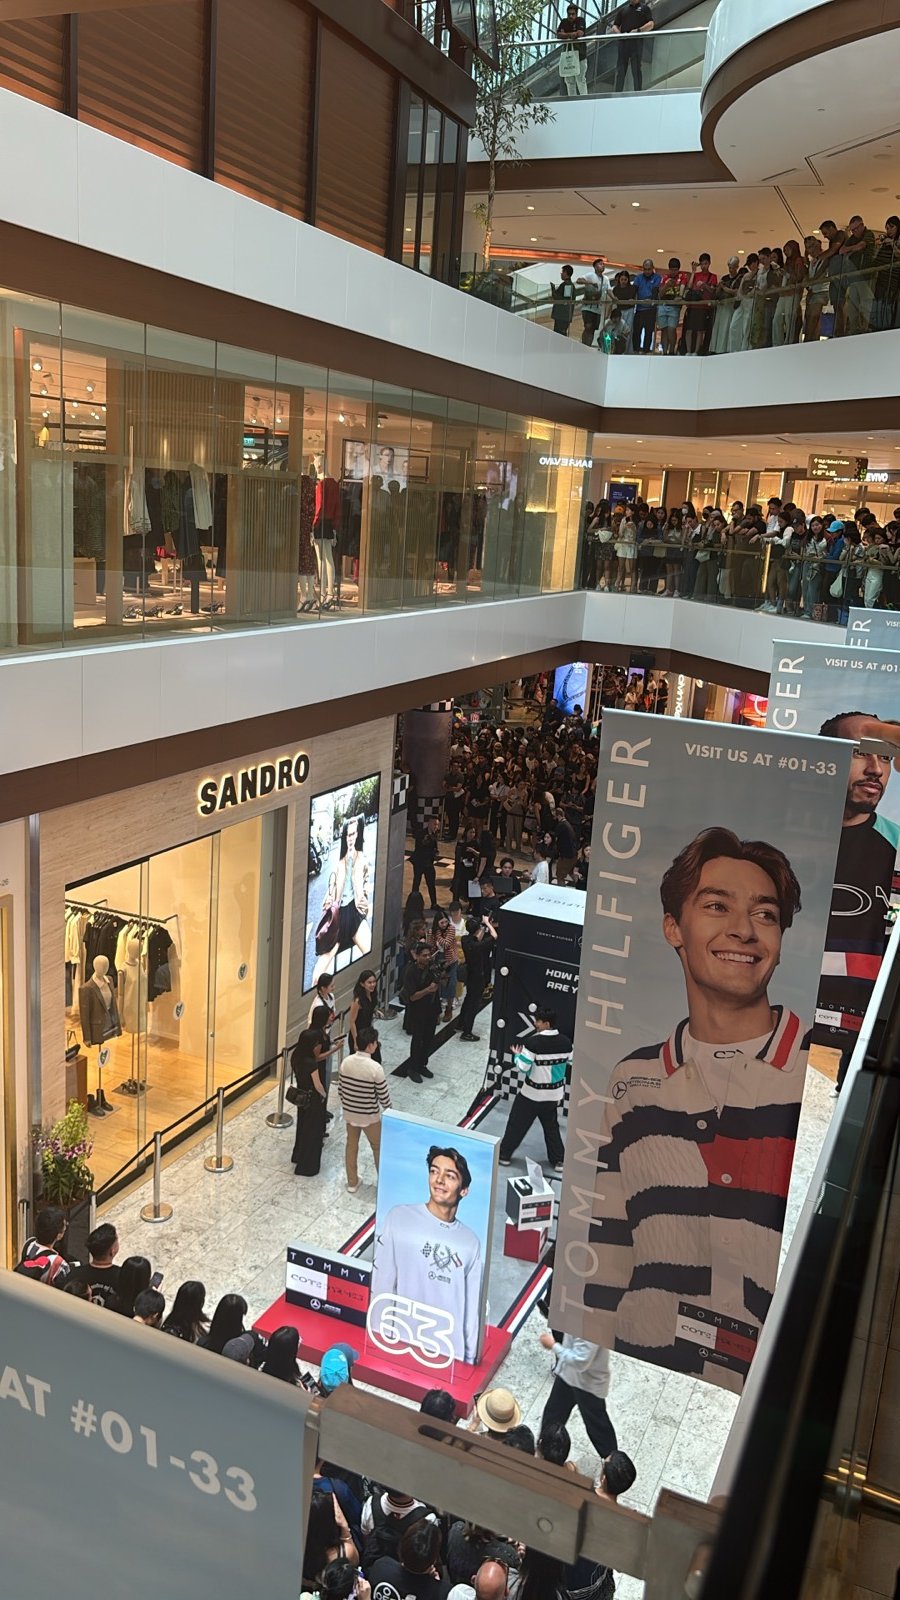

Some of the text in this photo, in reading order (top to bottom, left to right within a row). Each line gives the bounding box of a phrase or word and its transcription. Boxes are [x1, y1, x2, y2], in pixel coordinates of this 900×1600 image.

[825, 658, 848, 668] VISIT
[851, 661, 863, 669] US
[866, 662, 878, 670] AT
[685, 743, 837, 776] VISIT US AT #01-33
[199, 753, 310, 815] SANDRO
[585, 737, 651, 1035] HILFIGER
[545, 968, 572, 981] HOW
[546, 981, 570, 992] ARE
[819, 1002, 865, 1015] TOMMY
[560, 1078, 615, 1313] TOMMY
[290, 1252, 365, 1282] TOMMY
[367, 1293, 454, 1369] 63
[682, 1305, 754, 1336] TOMMY
[0, 1365, 257, 1512] AT #01-33
